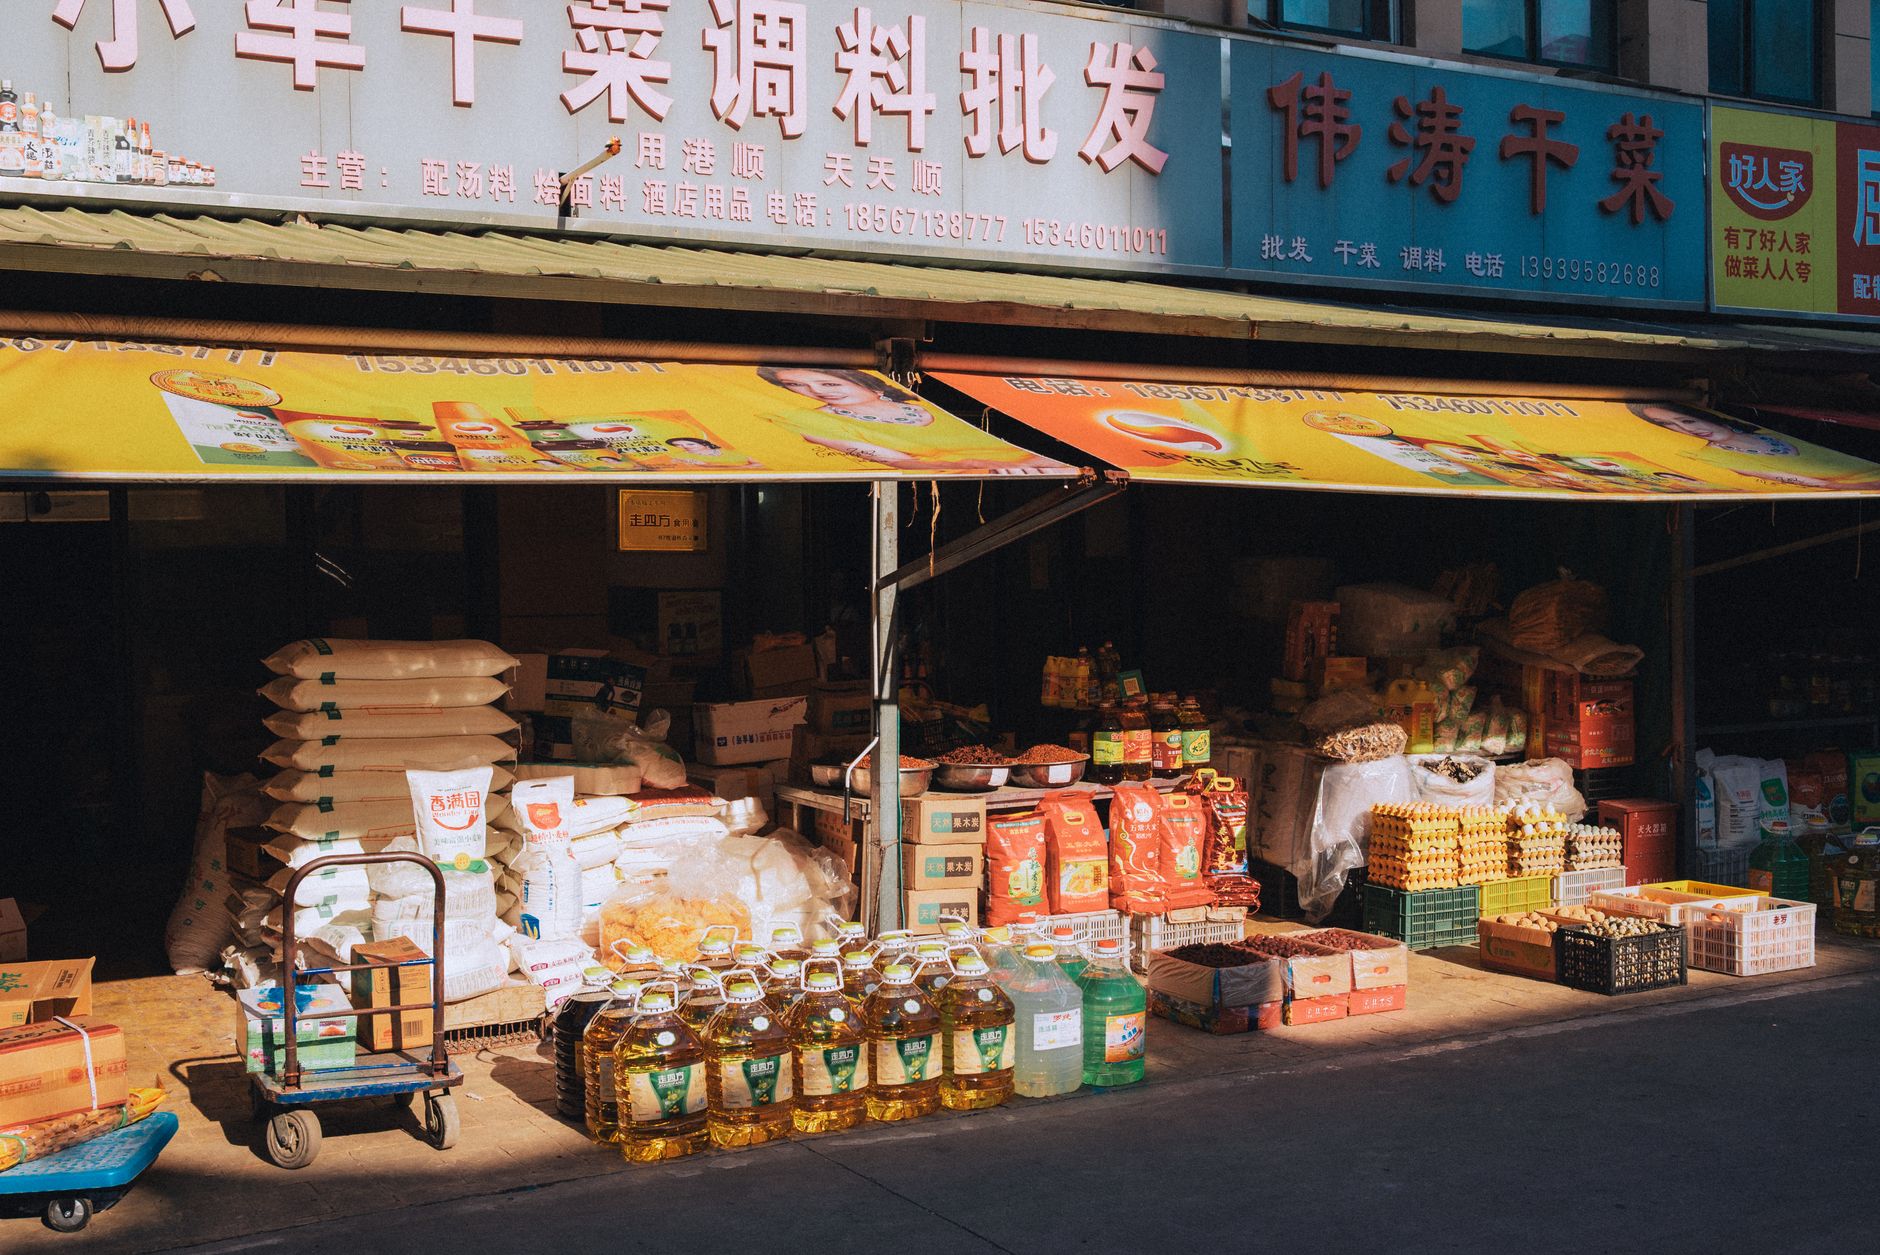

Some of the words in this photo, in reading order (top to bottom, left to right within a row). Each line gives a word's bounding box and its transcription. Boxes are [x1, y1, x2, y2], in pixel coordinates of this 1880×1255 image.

[1267, 70, 1675, 225] 伟涛干菜
[635, 131, 765, 180] 用港顺
[823, 152, 943, 197] 天天顺
[1728, 153, 1805, 193] 好人家
[300, 149, 388, 190] 主营：
[421, 158, 517, 202] 配汤料
[642, 178, 753, 222] 酒店用品
[845, 202, 1008, 243] 18567138777
[1022, 218, 1168, 255] 15346011011
[1723, 226, 1811, 254] 有了好人家
[1261, 233, 1313, 265] 批发
[1333, 239, 1381, 269] 干菜
[1400, 246, 1447, 273] 调料
[1465, 252, 1505, 278] 电话
[1520, 255, 1660, 288] 13939582688
[1725, 255, 1811, 283] 做菜人人夸
[630, 514, 670, 527] 走四方
[430, 791, 480, 811] 香满园
[953, 817, 979, 828] 果木炭
[946, 862, 972, 873] 果木炭
[980, 1030, 1001, 1040] 走四方
[904, 1040, 926, 1051] 走四方
[831, 1049, 853, 1060] 走四方
[750, 1061, 774, 1073] 走四方
[658, 1071, 684, 1084] 走四方
